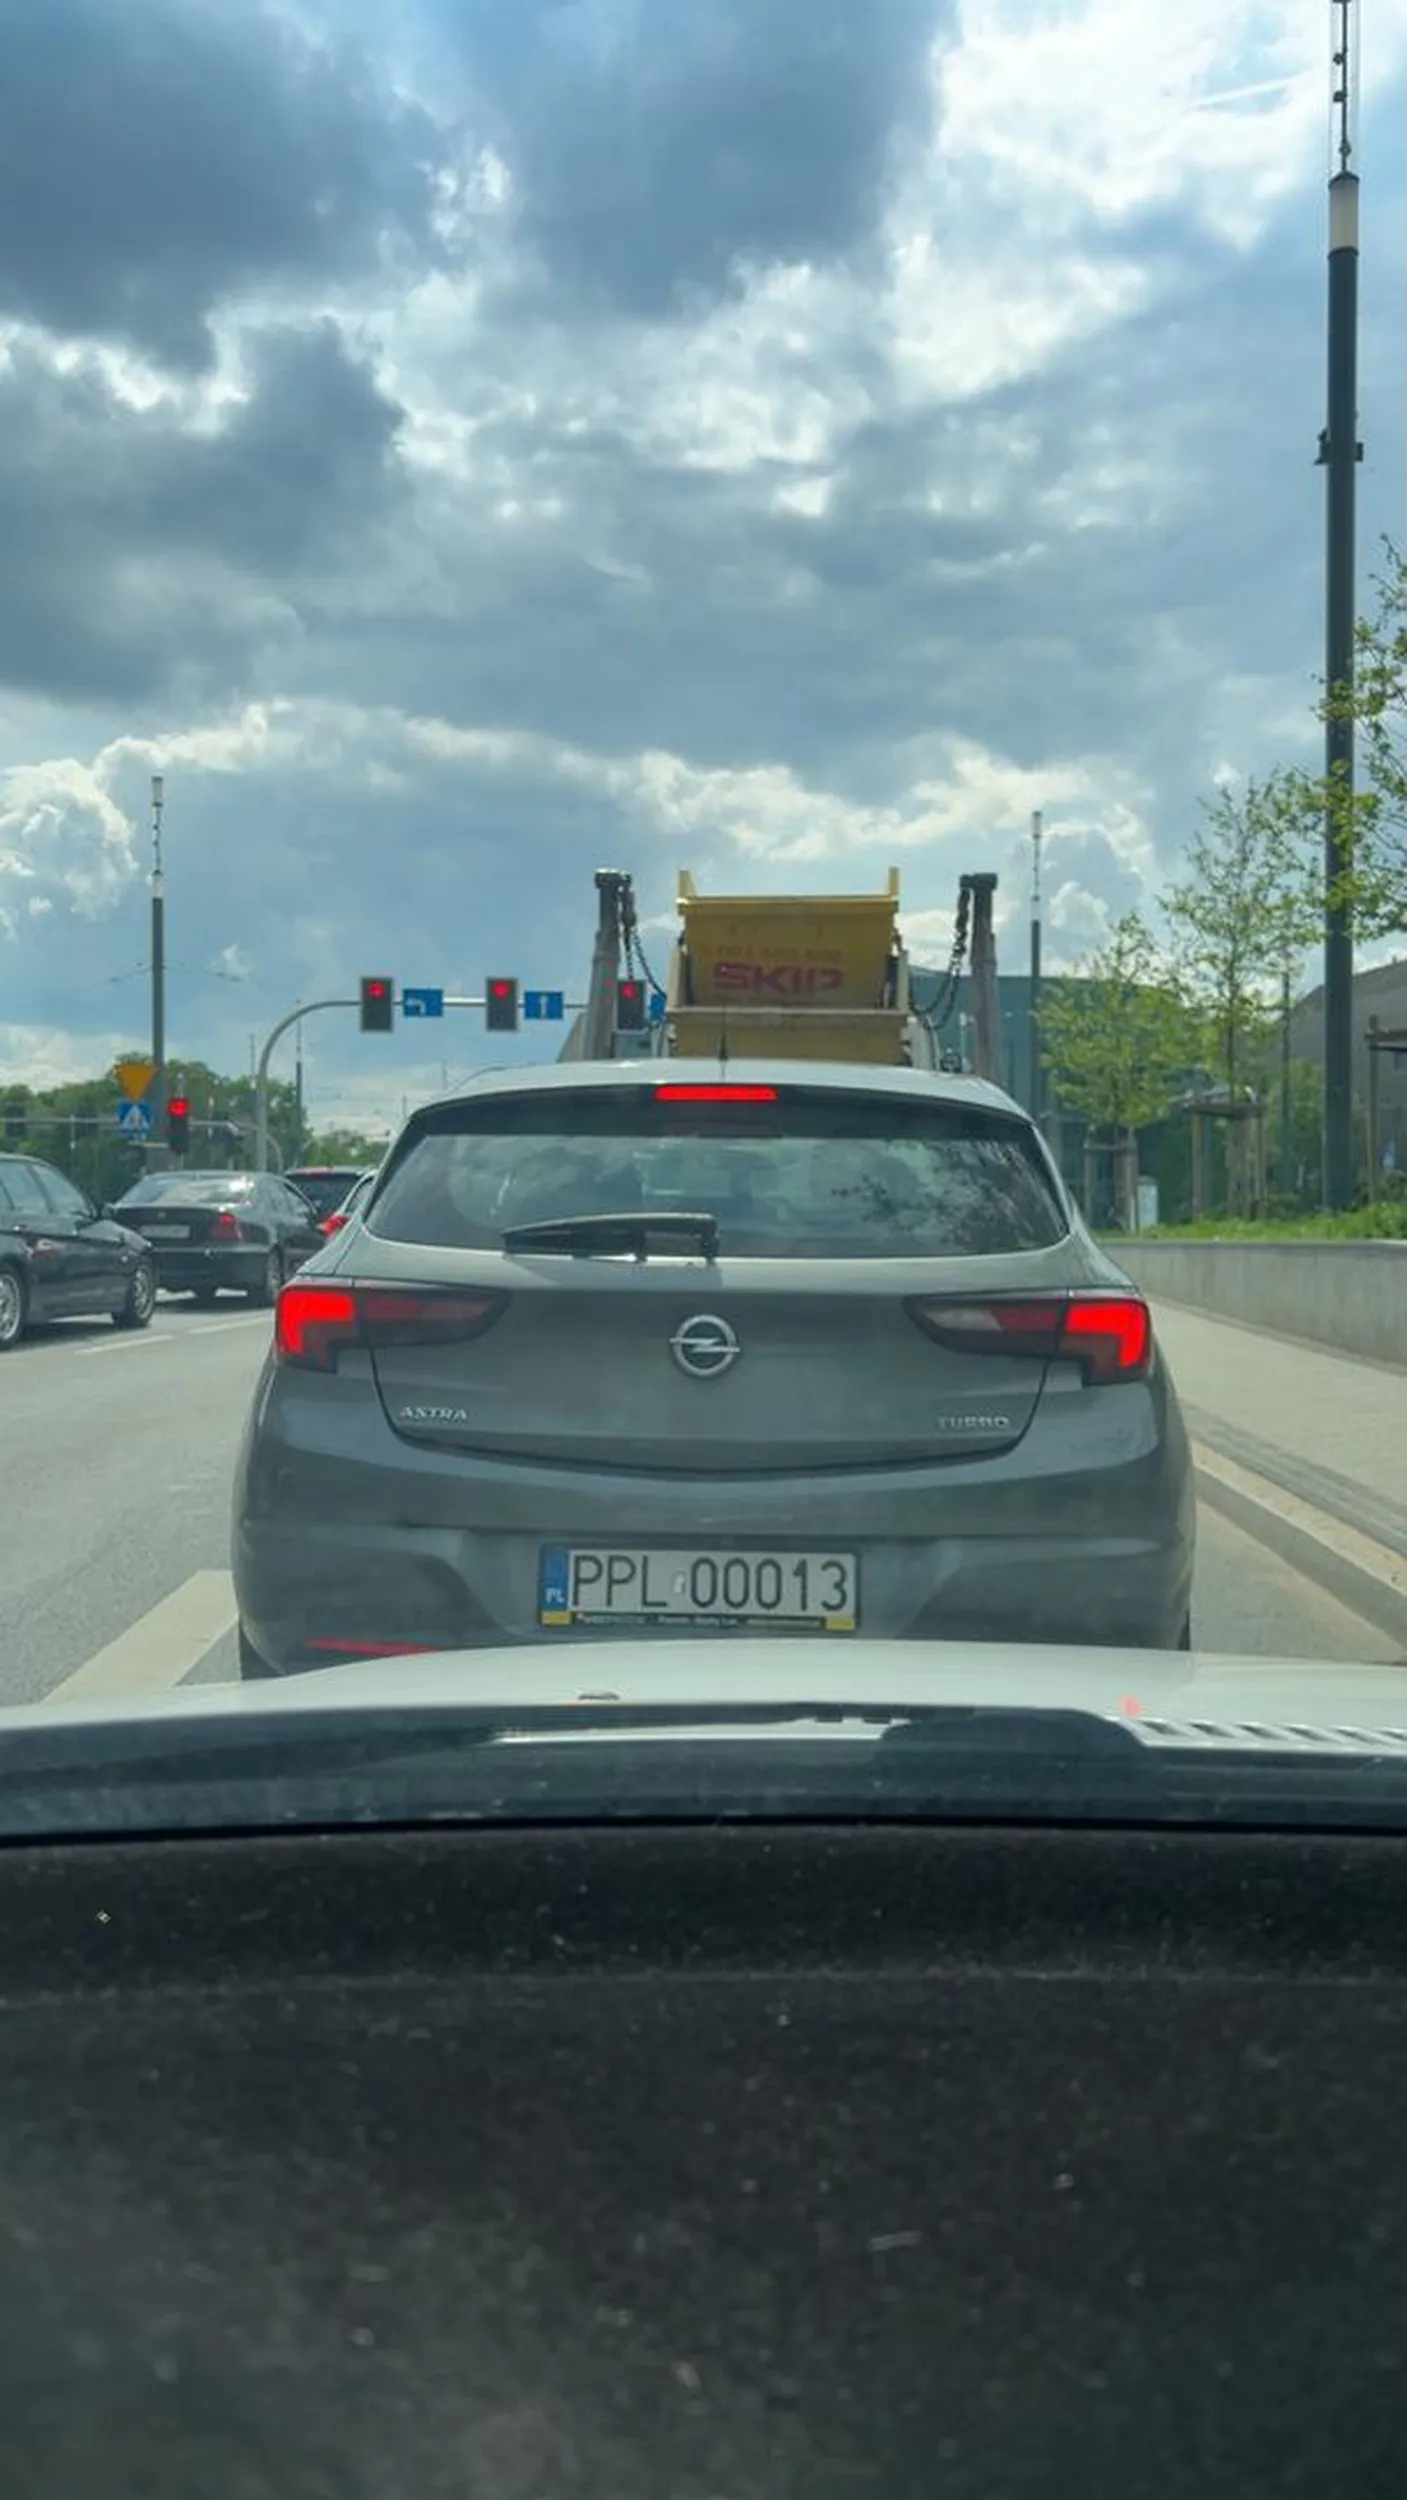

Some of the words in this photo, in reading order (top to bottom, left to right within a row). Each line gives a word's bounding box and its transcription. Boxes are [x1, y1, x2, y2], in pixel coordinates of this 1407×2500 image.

[715, 961, 843, 994] SKIP
[400, 1406, 467, 1420] ASTRA
[938, 1415, 1010, 1429] TURBO
[572, 1554, 667, 1608] PPL
[690, 1557, 848, 1612] 00013
